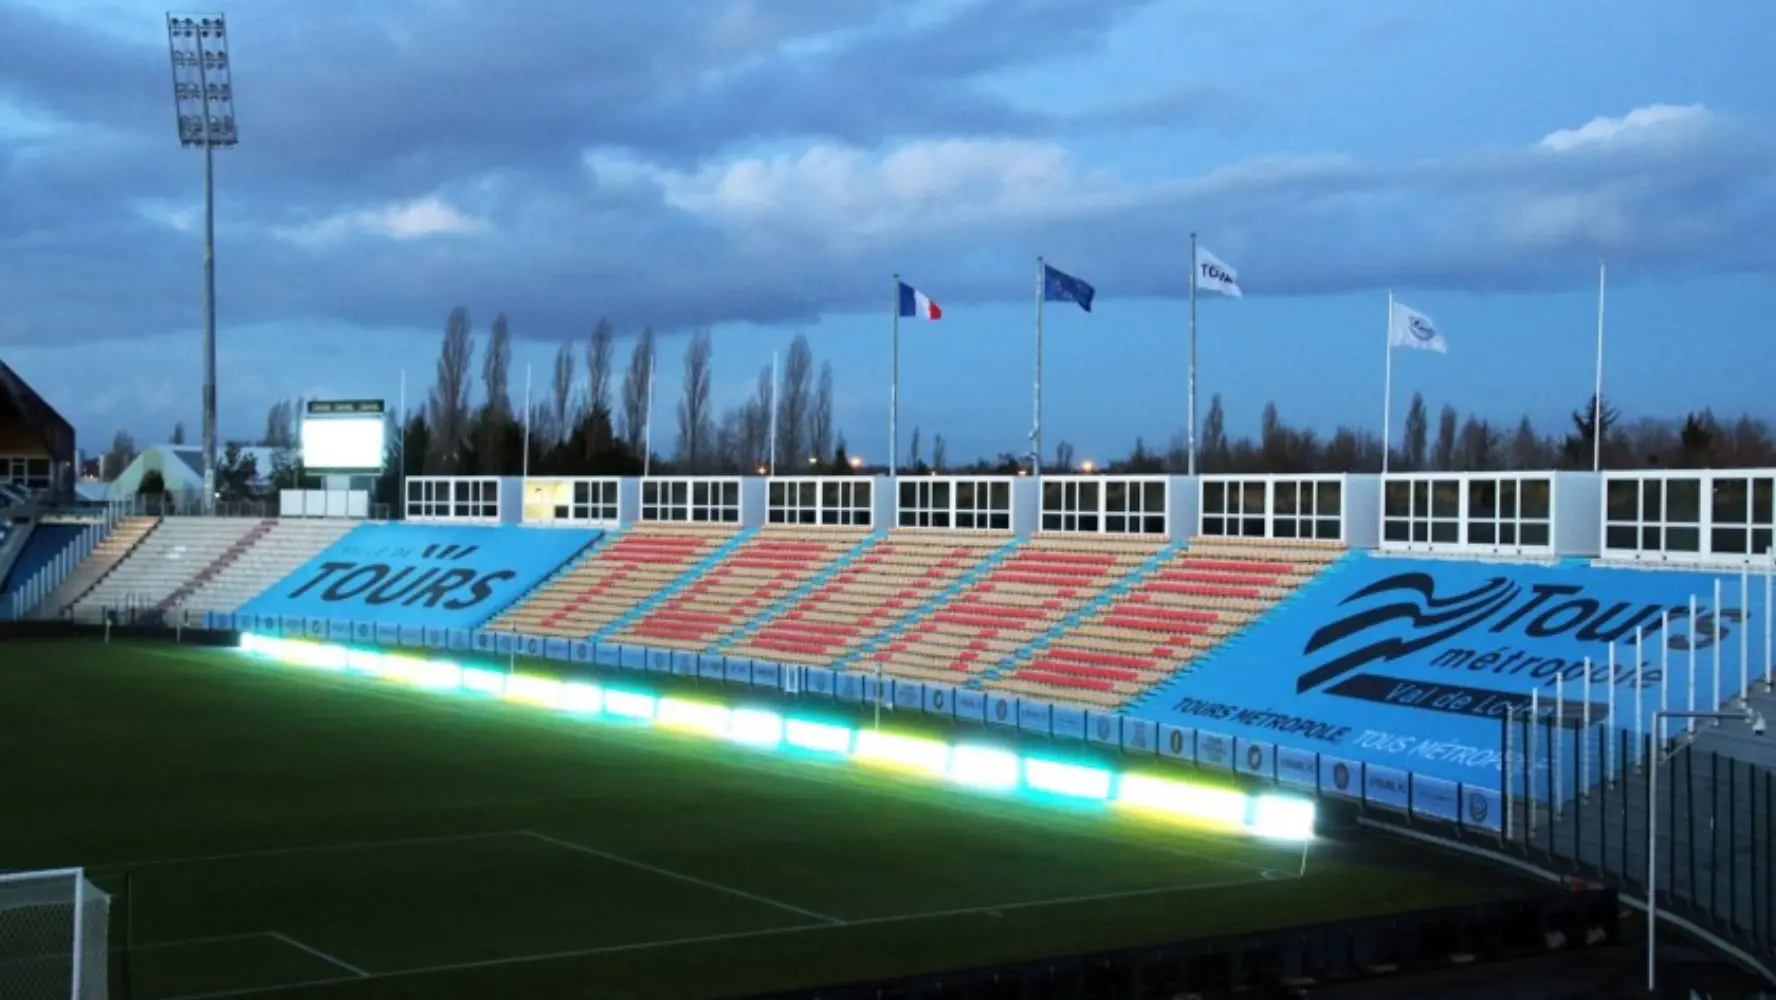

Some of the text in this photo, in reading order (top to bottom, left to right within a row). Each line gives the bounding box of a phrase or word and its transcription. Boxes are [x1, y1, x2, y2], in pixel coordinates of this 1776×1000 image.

[288, 561, 516, 610] TOURS
[1488, 584, 1751, 651] Tours
[1429, 646, 1665, 688] métropole
[1386, 682, 1436, 703] Val
[1432, 688, 1473, 708] de
[1172, 697, 1352, 746] TOURS MÉTROPOLE
[1353, 730, 1558, 776] TOUS MÉTROP
